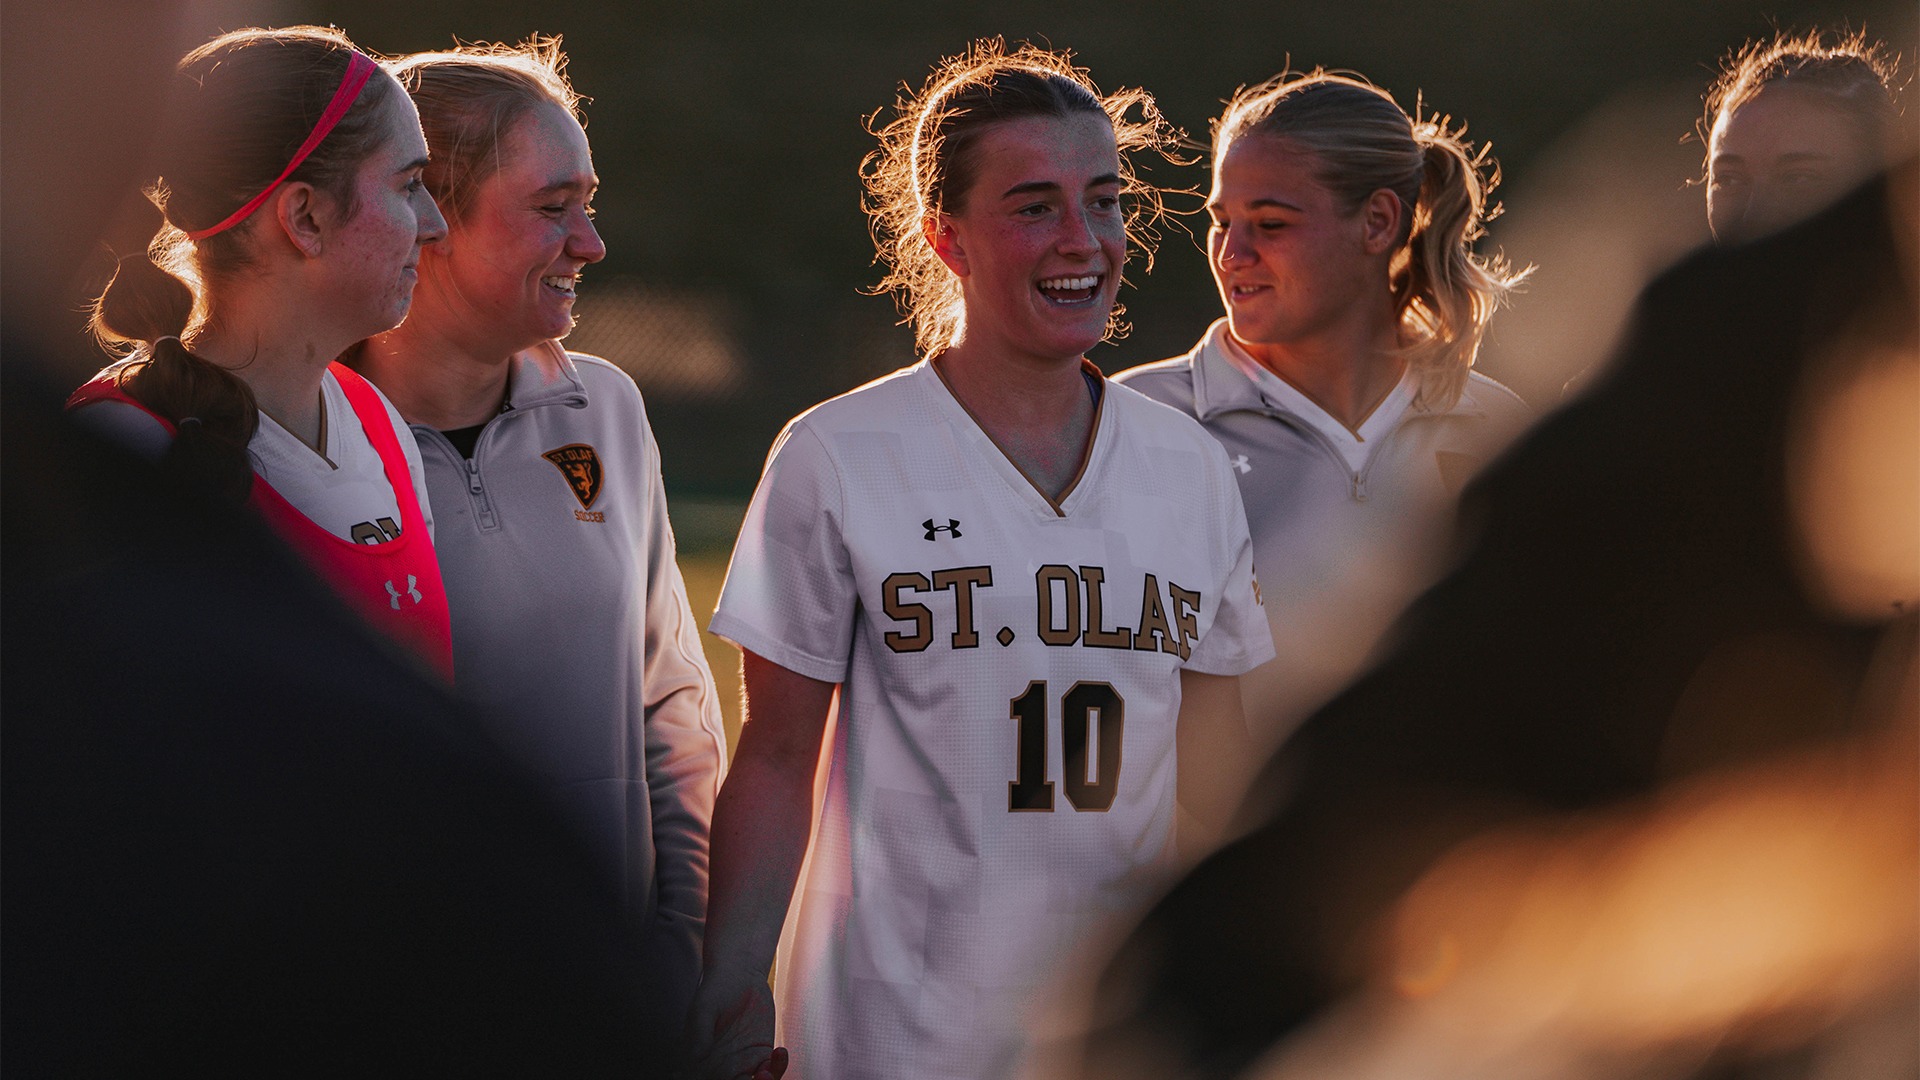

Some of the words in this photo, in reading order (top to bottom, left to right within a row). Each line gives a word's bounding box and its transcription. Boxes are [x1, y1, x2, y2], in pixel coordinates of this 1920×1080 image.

[566, 449, 593, 461] OLAF
[574, 510, 606, 523] SOCCER
[882, 565, 1015, 653] ST.
[1035, 564, 1201, 661] OLAF
[1008, 680, 1125, 813] 10
